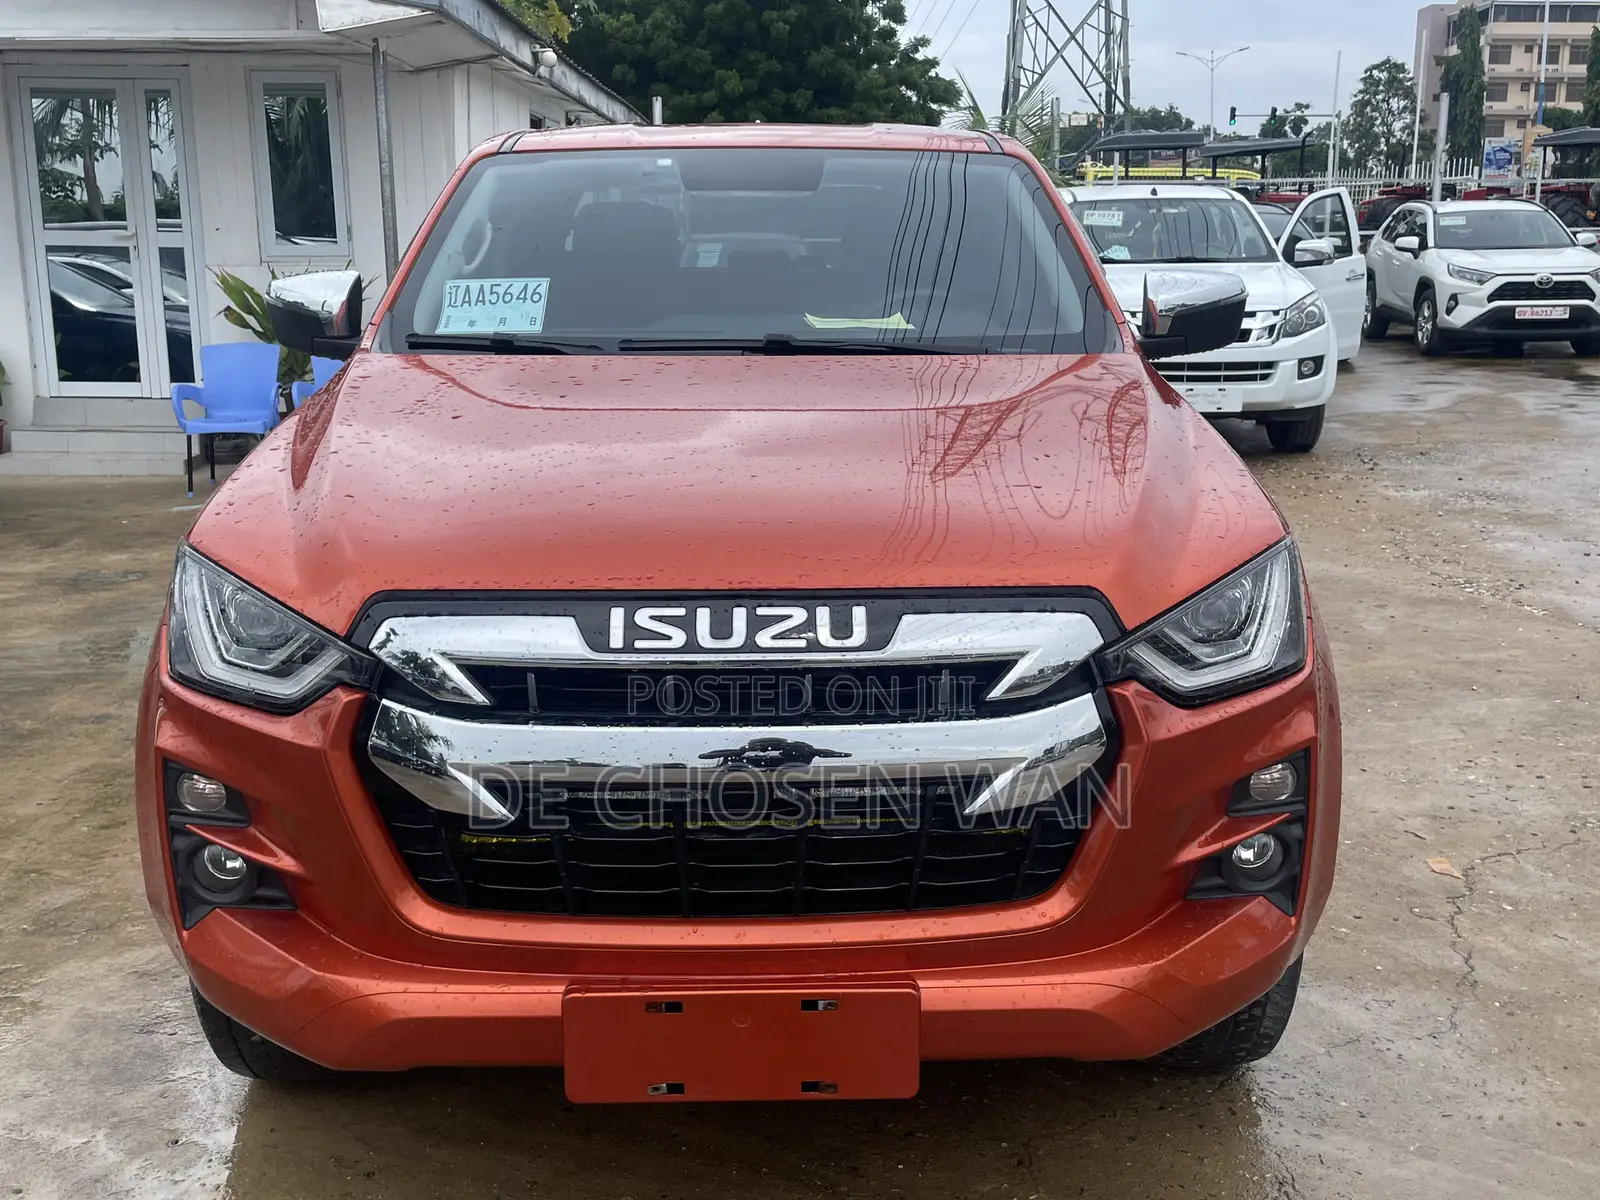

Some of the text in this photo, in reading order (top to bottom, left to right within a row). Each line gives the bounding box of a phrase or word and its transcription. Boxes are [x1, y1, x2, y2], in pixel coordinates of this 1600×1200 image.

[446, 283, 543, 308] 辽AA5646
[498, 317, 507, 327] 月
[529, 316, 537, 326] 日
[609, 606, 868, 649] ISUZU
